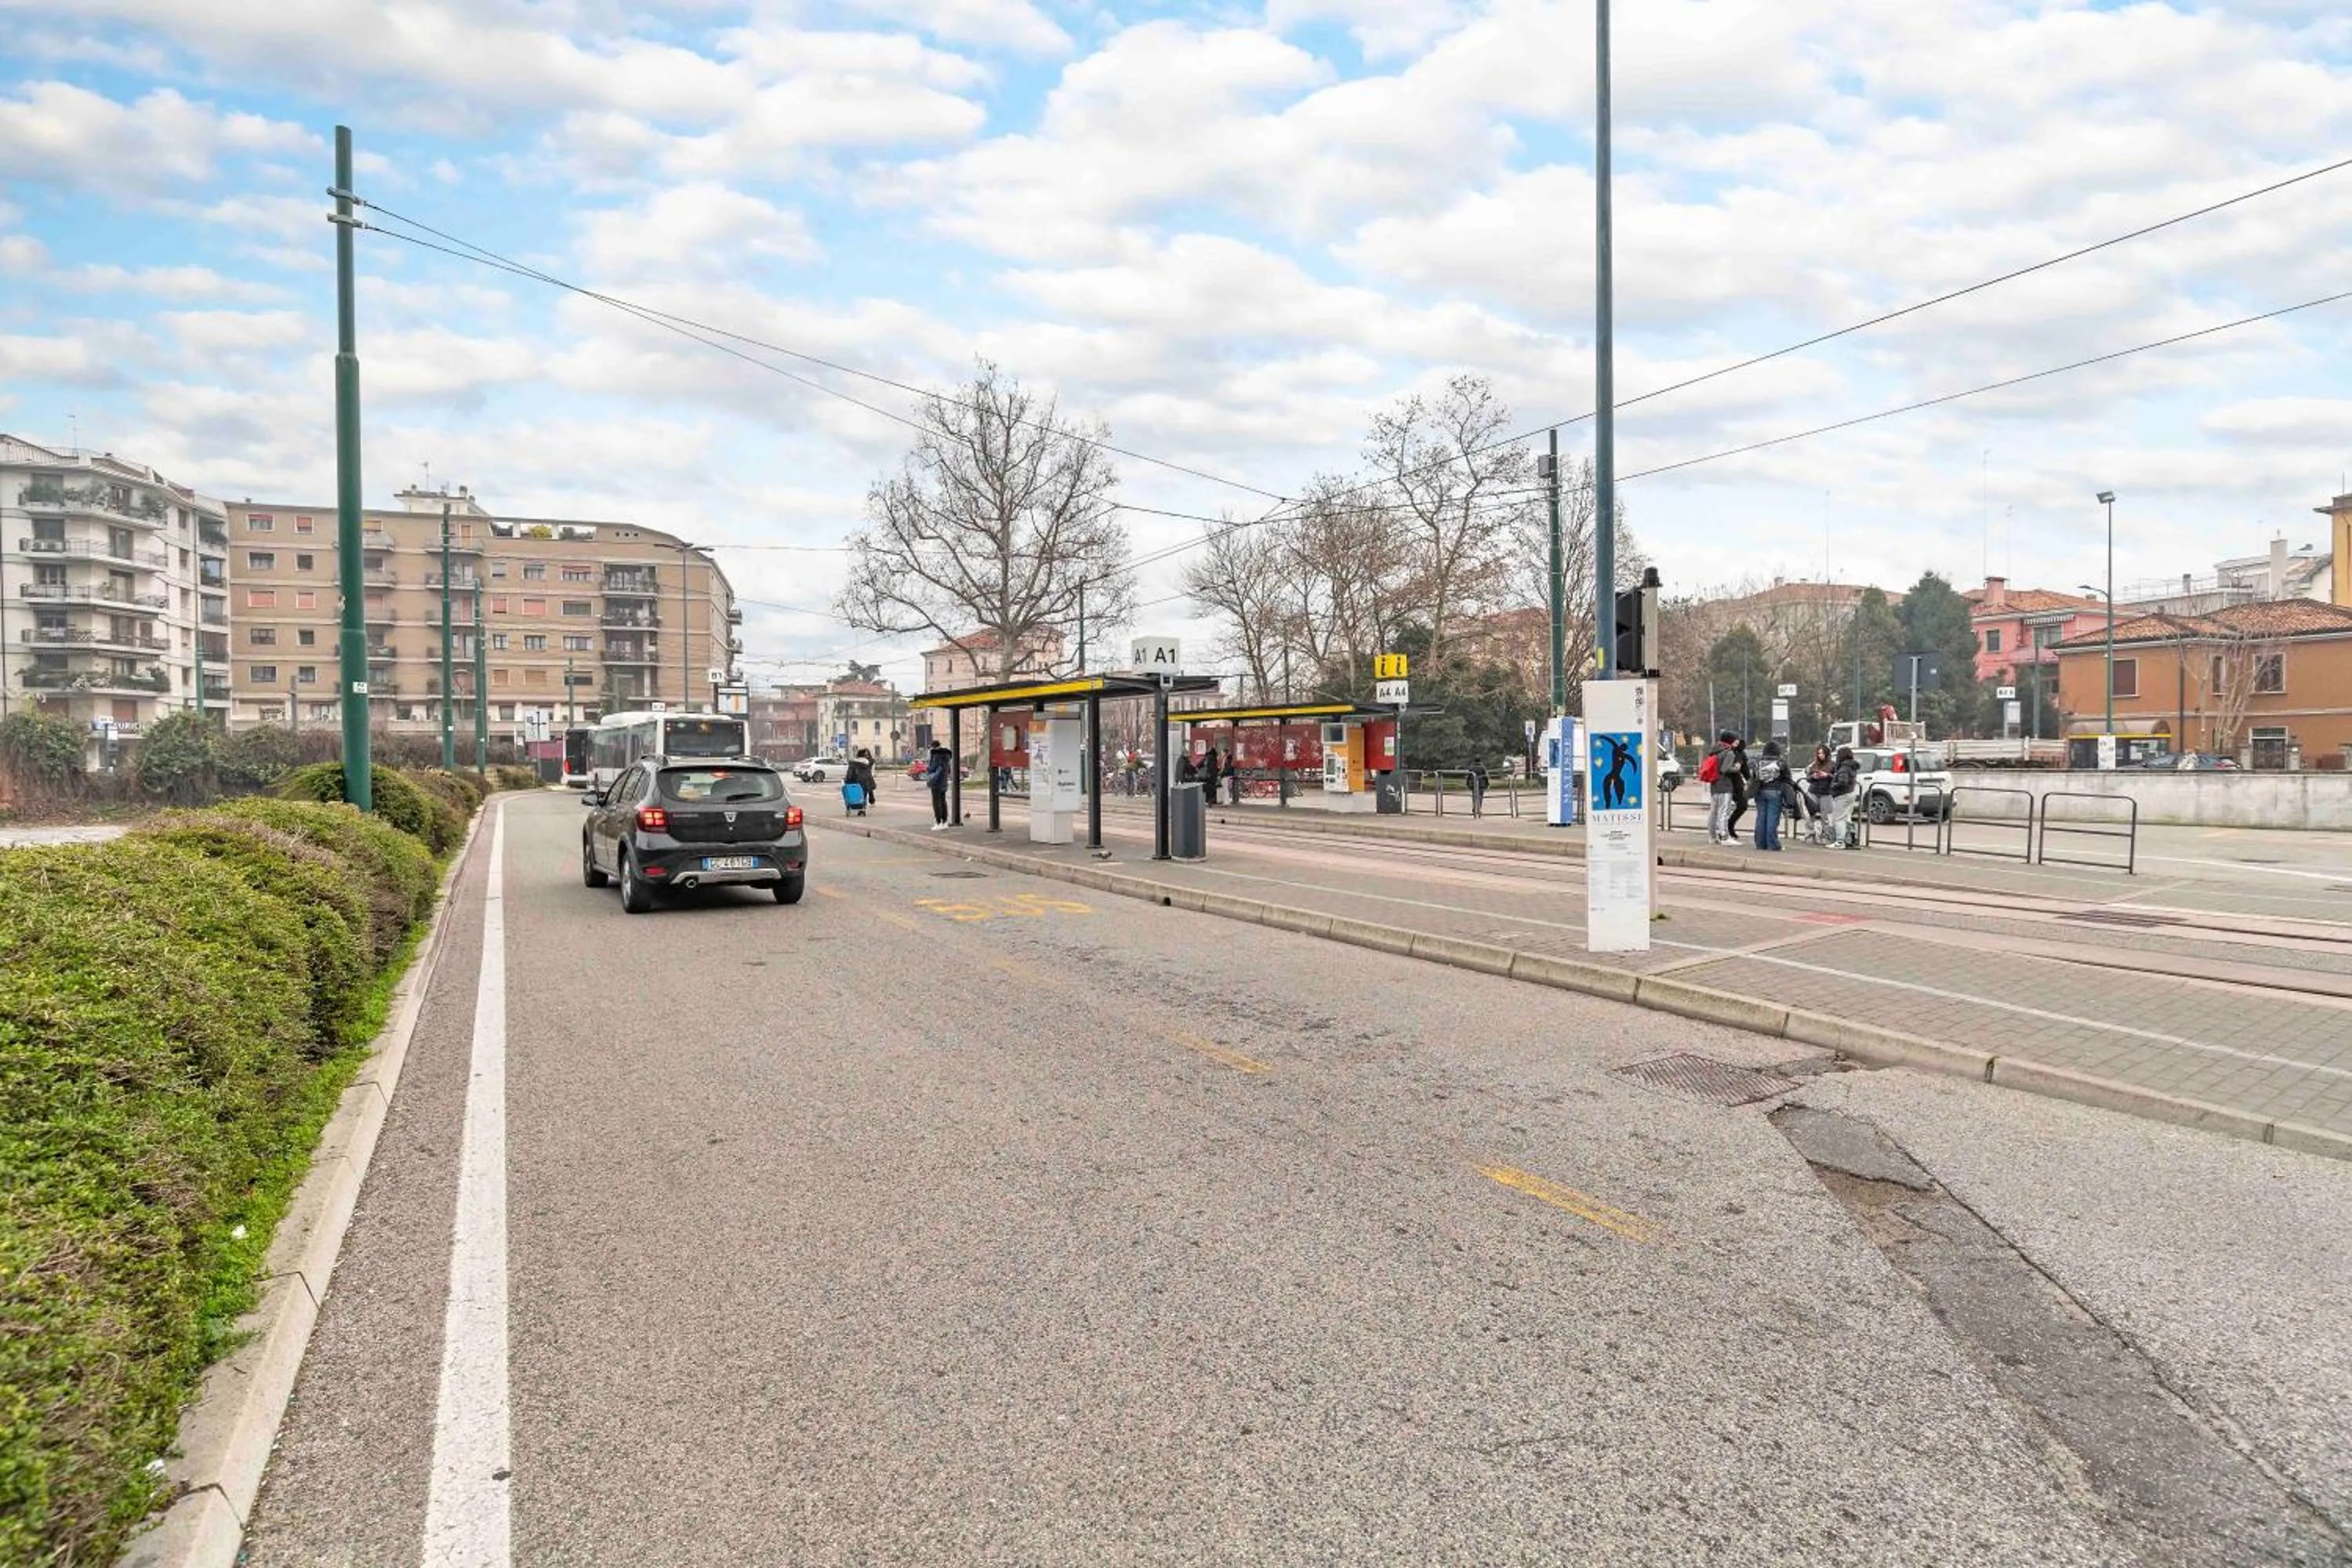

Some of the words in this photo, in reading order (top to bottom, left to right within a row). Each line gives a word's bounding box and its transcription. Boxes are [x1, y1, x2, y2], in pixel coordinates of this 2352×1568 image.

[1134, 648, 1147, 665] A1
[1153, 646, 1175, 664] A1
[1592, 812, 1644, 823] MATISSE
